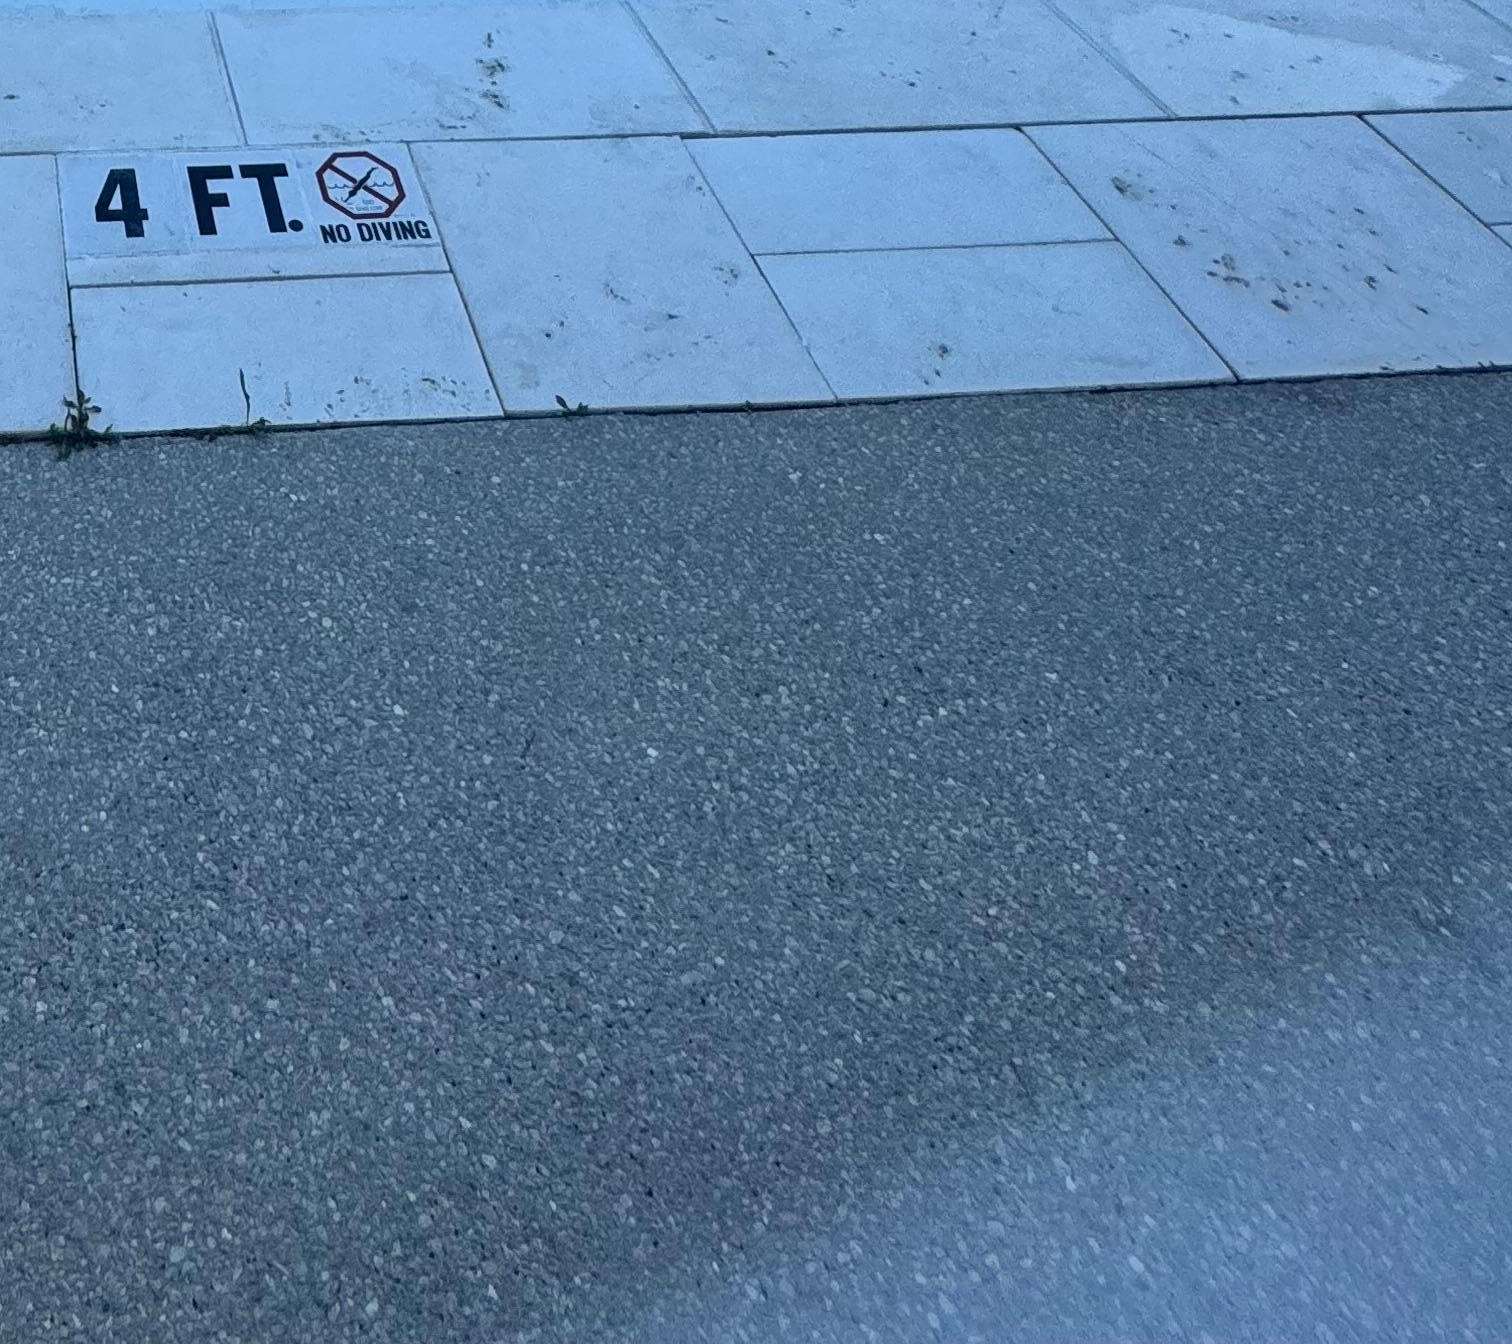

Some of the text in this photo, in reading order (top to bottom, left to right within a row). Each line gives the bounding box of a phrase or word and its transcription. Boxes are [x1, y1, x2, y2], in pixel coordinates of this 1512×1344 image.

[94, 163, 304, 238] 4 FT.
[320, 219, 432, 244] NO DIVING
